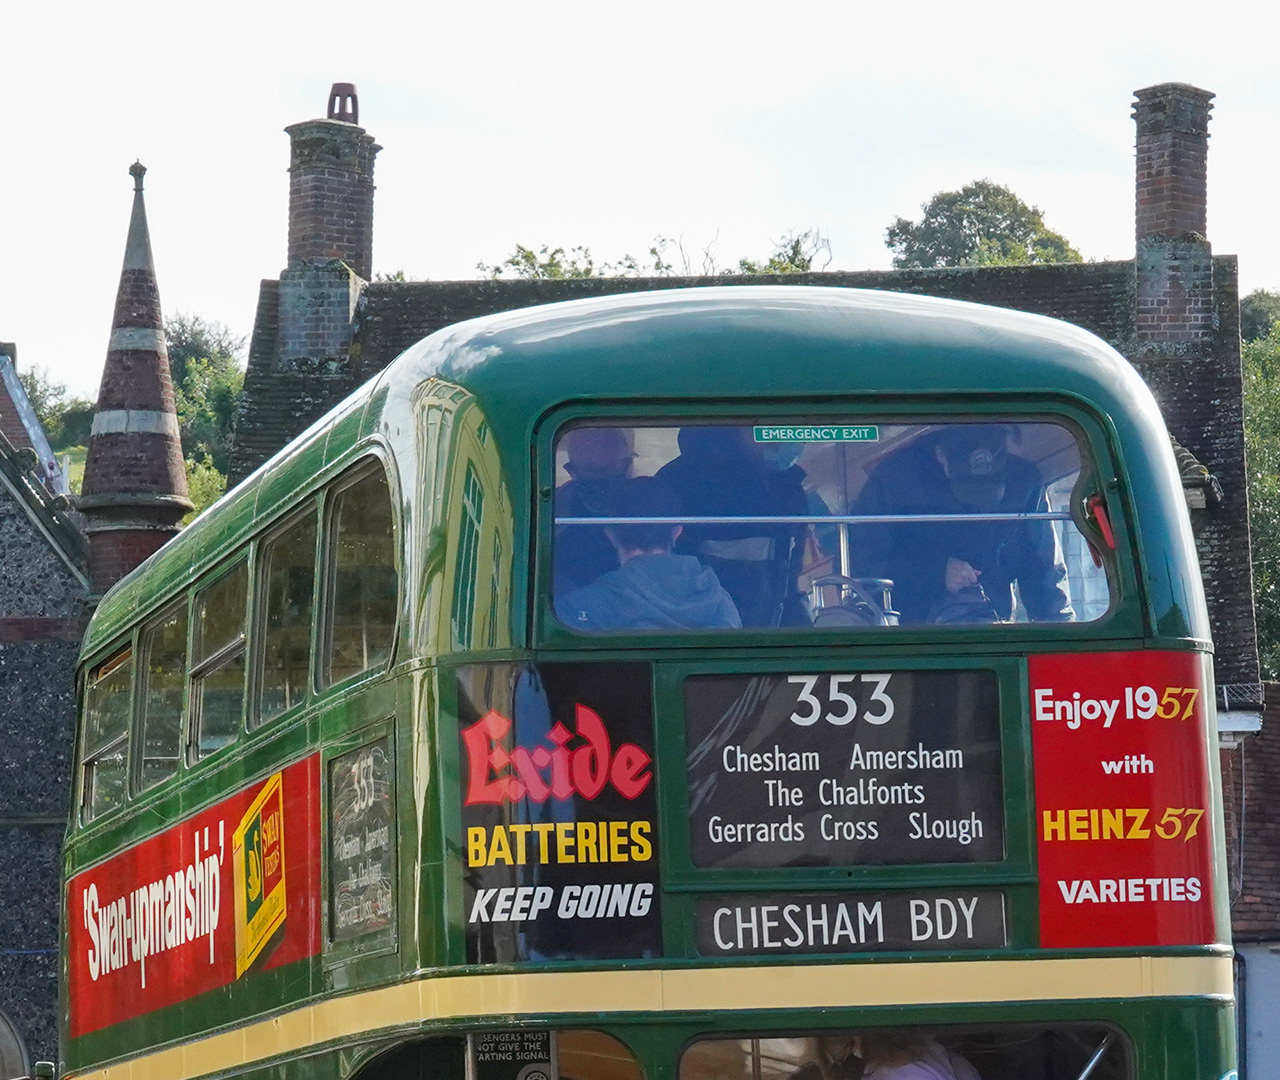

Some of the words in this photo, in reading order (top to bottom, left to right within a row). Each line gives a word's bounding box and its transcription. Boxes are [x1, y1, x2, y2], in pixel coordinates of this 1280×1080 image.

[762, 428, 838, 439] EMERGENCY
[842, 428, 869, 439] EXIT
[787, 673, 895, 726] 353
[1034, 688, 1120, 730] Enjoy
[1124, 685, 1199, 721] 1957
[461, 703, 652, 807] Exide
[722, 744, 820, 772] Chesham
[849, 742, 963, 770] Amersham
[1101, 754, 1154, 774] with
[764, 779, 804, 806] The
[819, 778, 926, 806] Chalfonts
[708, 815, 805, 843] Gerrards
[820, 814, 879, 841] Cross
[909, 812, 983, 844] Slough
[1043, 808, 1151, 841] HEINZ
[1154, 807, 1205, 844] 57
[468, 820, 652, 868] BATTERIES
[469, 886, 554, 924] KEEP
[557, 882, 654, 919] GOING
[1057, 876, 1202, 904] VARIETIES
[713, 900, 884, 950] CHESHAM
[909, 897, 978, 942] BDY
[482, 1032, 521, 1042] SENGERS
[524, 1032, 548, 1041] MUST
[498, 1042, 520, 1051] GIVE
[523, 1042, 542, 1050] THE
[476, 1052, 512, 1061] ARTING
[516, 1051, 549, 1060] SIGNAL
